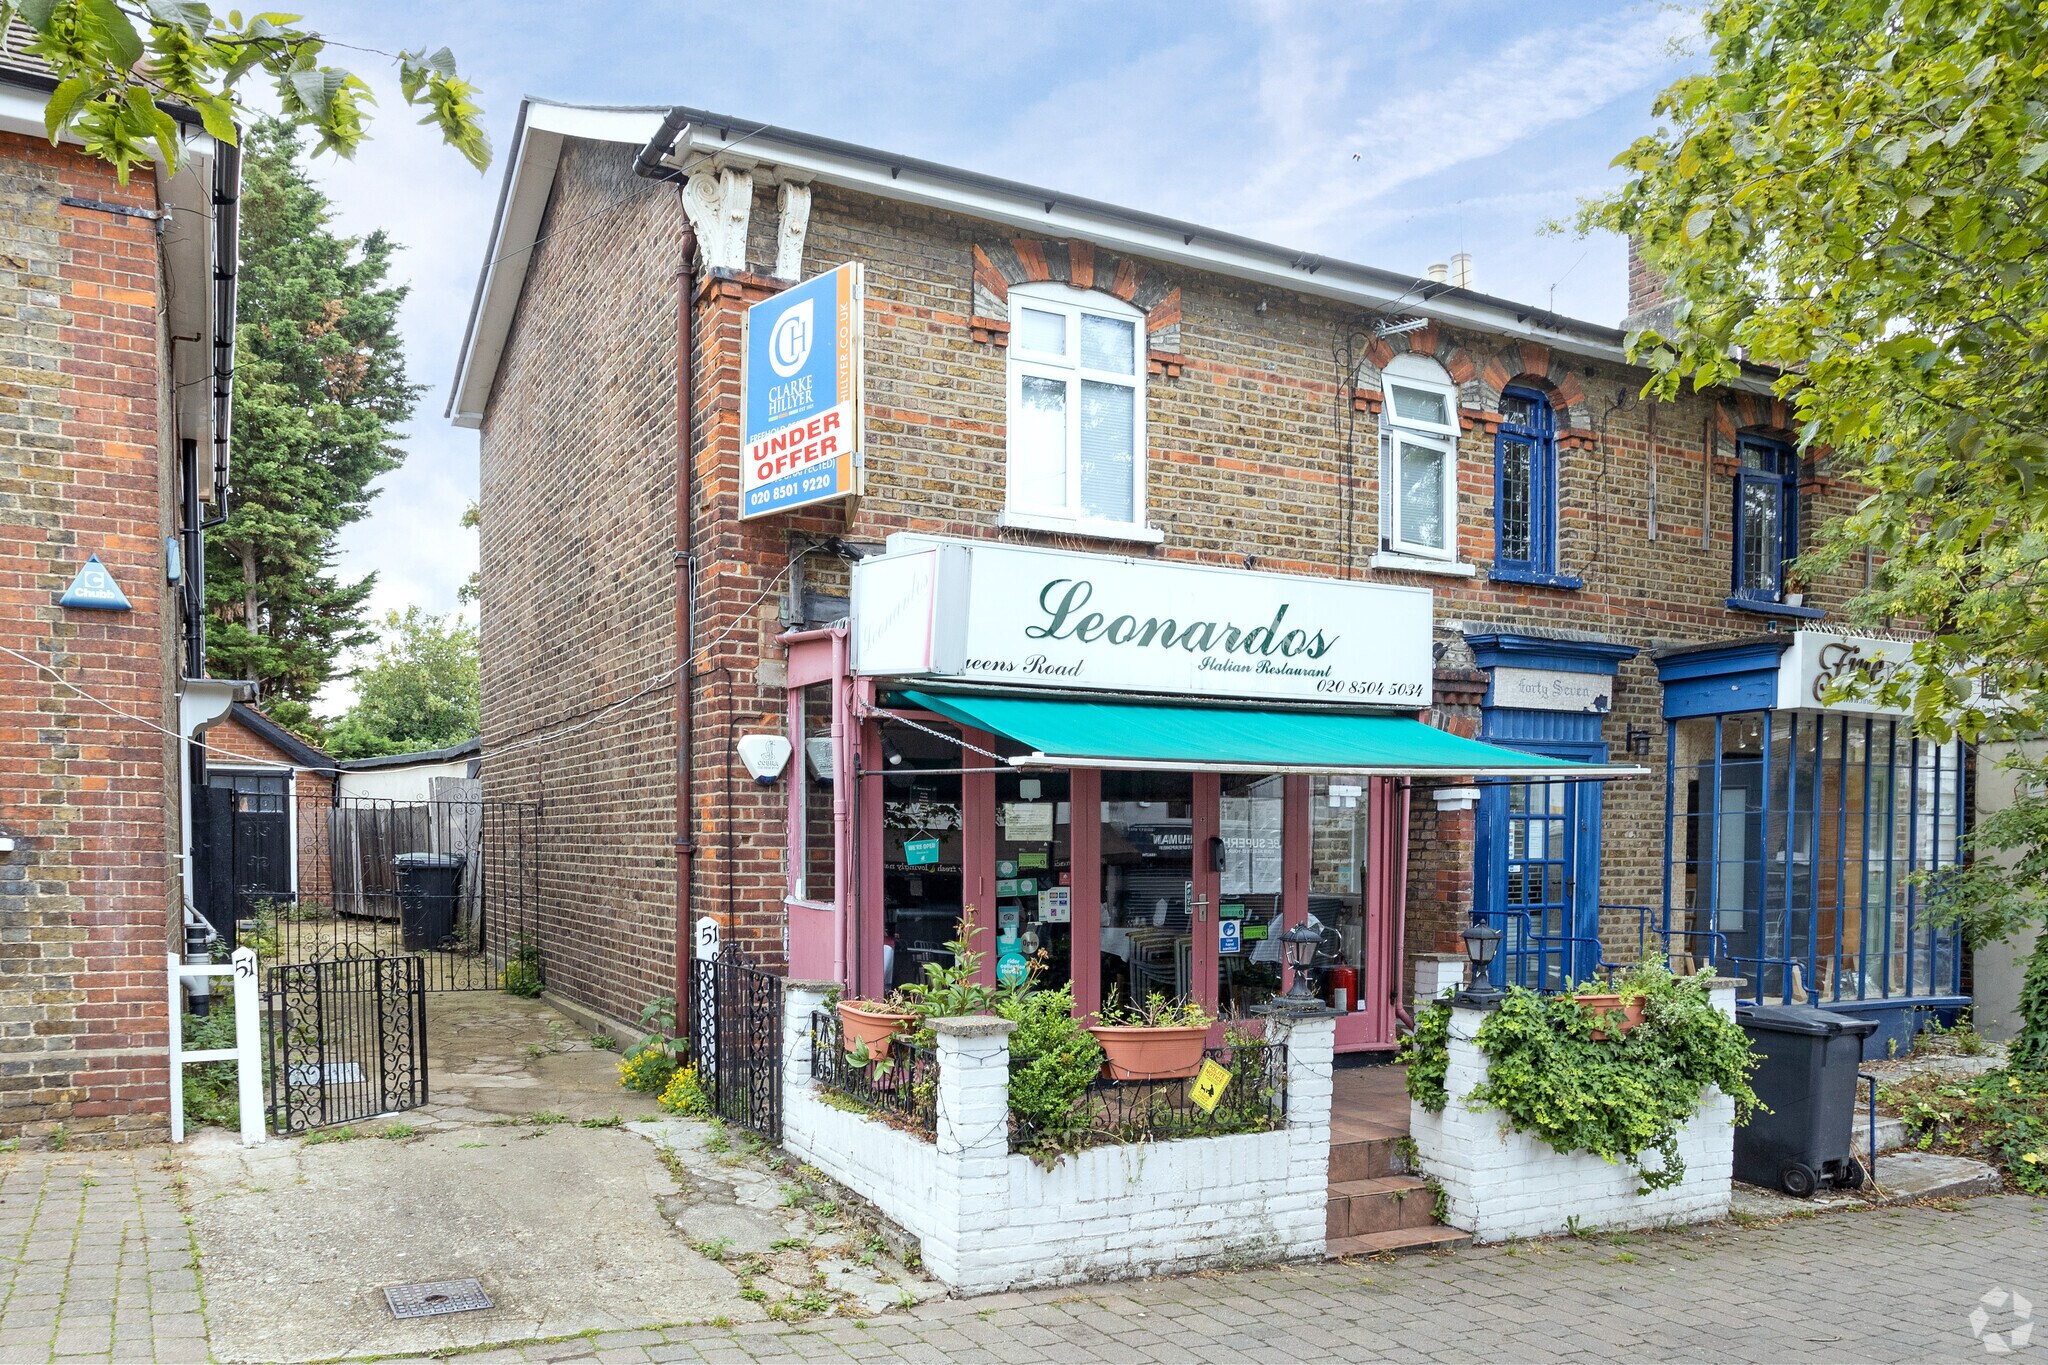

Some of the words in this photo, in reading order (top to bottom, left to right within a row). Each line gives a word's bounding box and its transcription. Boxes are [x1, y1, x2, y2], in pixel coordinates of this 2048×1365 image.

[768, 374, 813, 402] CLARKE
[768, 390, 814, 416] HILLYER
[753, 411, 840, 461] UNDER
[757, 435, 837, 481] OFFER
[751, 489, 771, 505] 020
[773, 482, 798, 500] 8501
[802, 474, 830, 493] 9220
[75, 588, 116, 599] Chubb
[1025, 579, 1341, 659] Leonardos
[1022, 653, 1084, 677] Road
[1198, 656, 1252, 673] Italian
[1255, 660, 1333, 678] Restaurant
[1316, 679, 1345, 693] 020
[1348, 680, 1385, 696] 8504
[1388, 683, 1425, 698] 5034
[1551, 679, 1590, 698] Seven
[702, 925, 718, 947] 51
[1022, 940, 1038, 949] Open
[235, 956, 255, 979] 51
